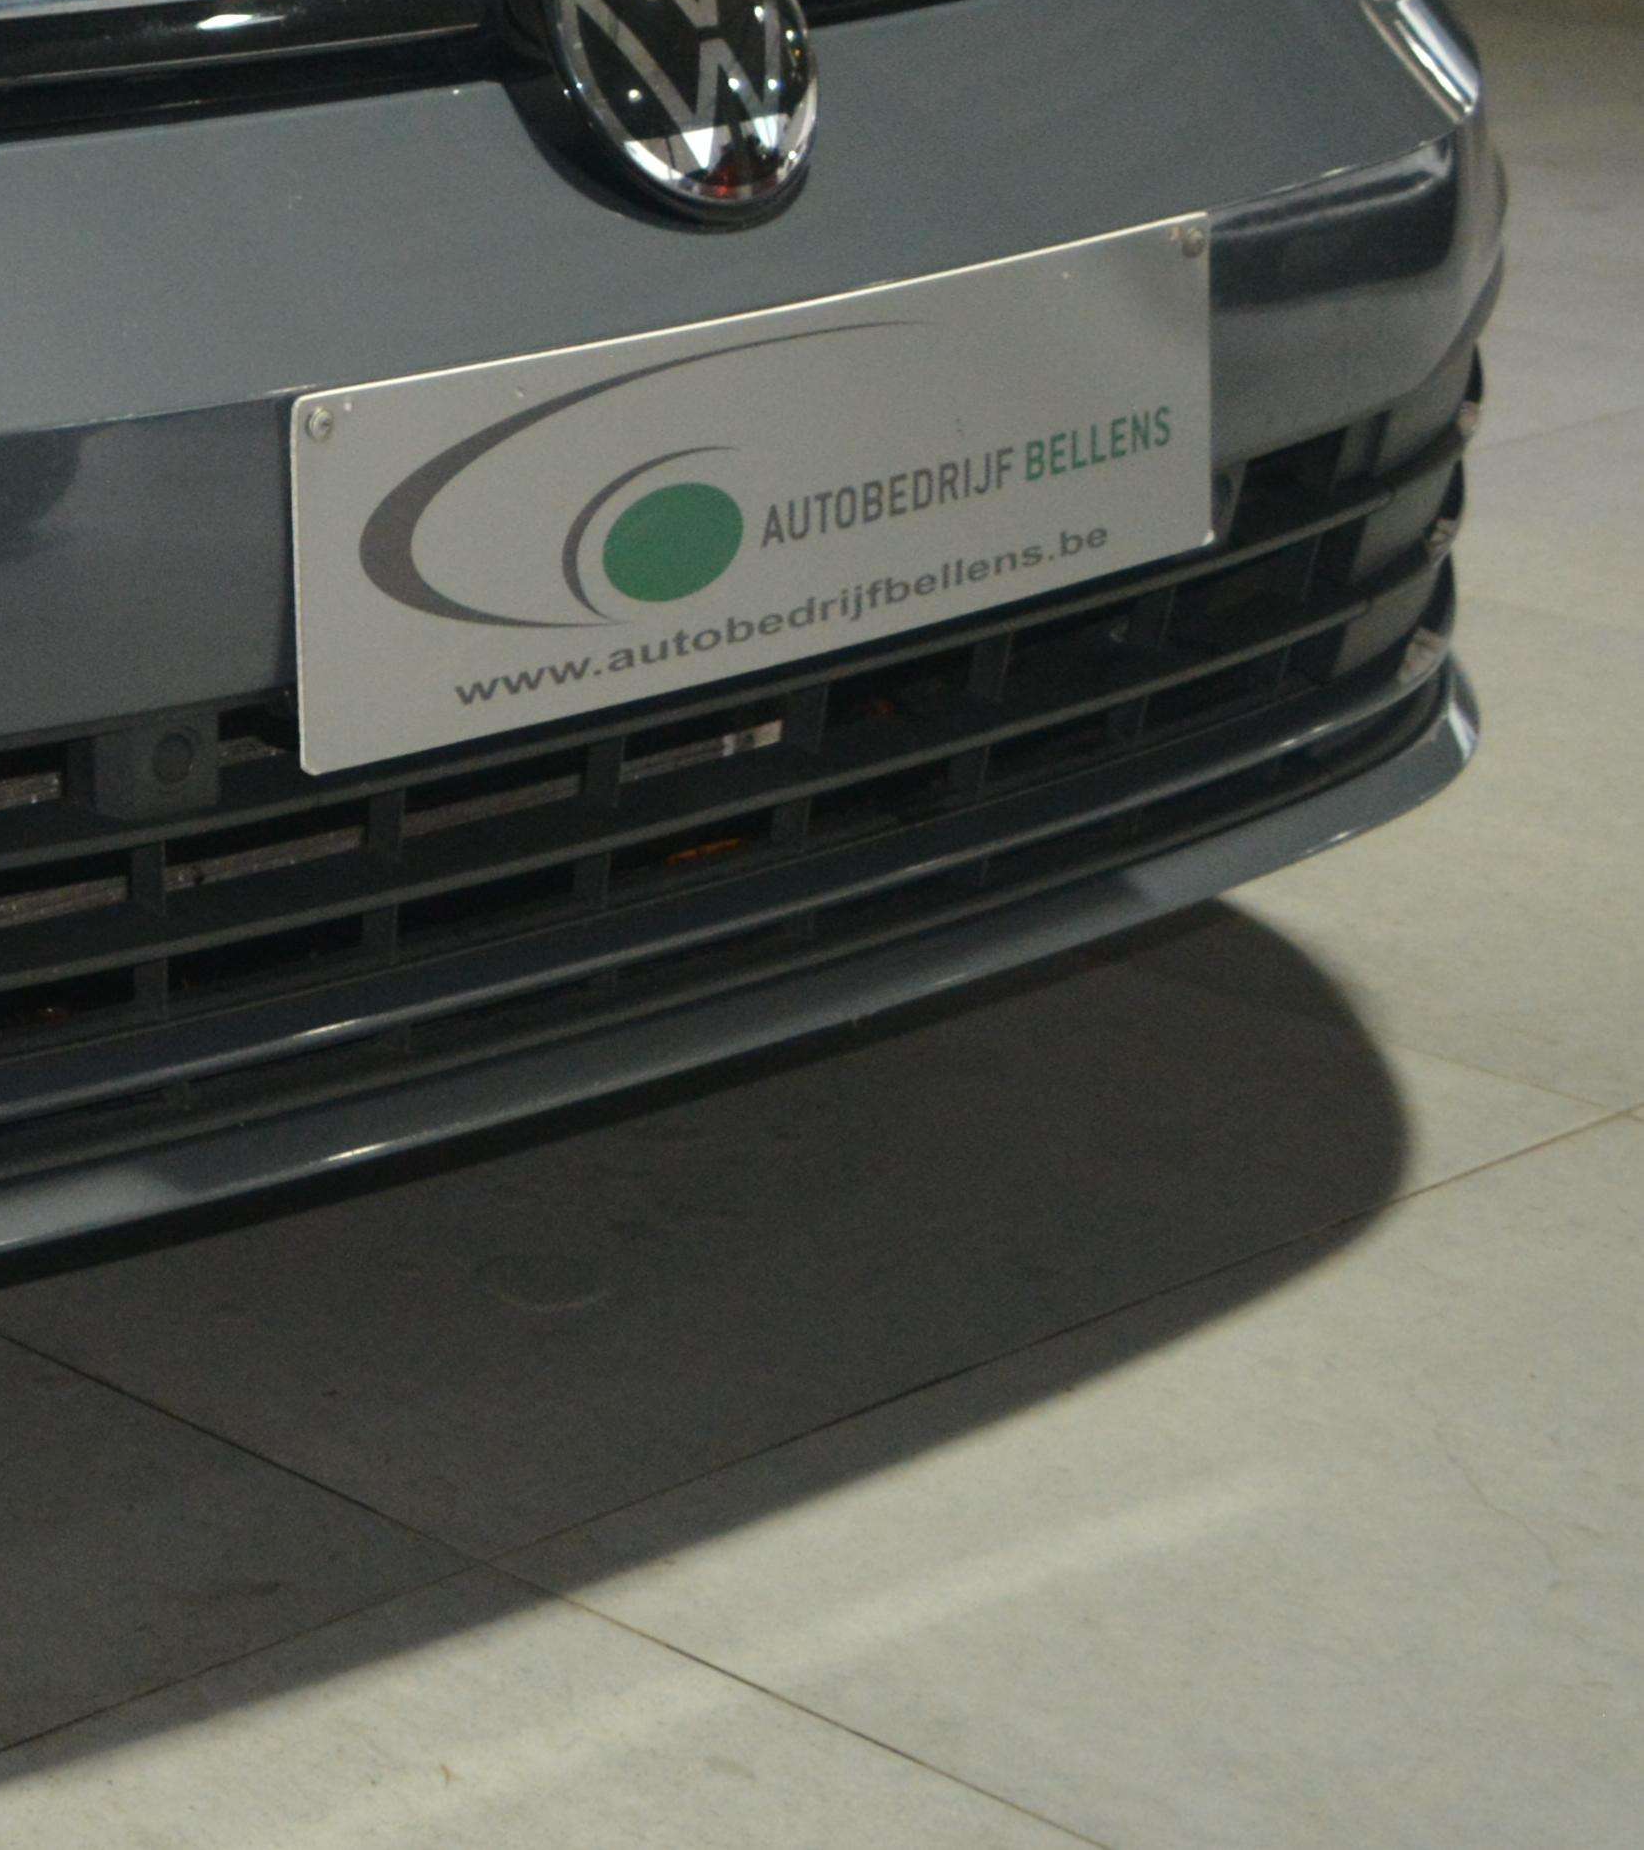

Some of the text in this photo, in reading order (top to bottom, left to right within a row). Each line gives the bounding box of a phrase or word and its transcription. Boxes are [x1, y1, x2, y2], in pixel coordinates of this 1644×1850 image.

[759, 405, 1173, 549] AUTOBEDRIJF BELLENS
[454, 526, 1109, 707] www.autobedrijfbellens.be
